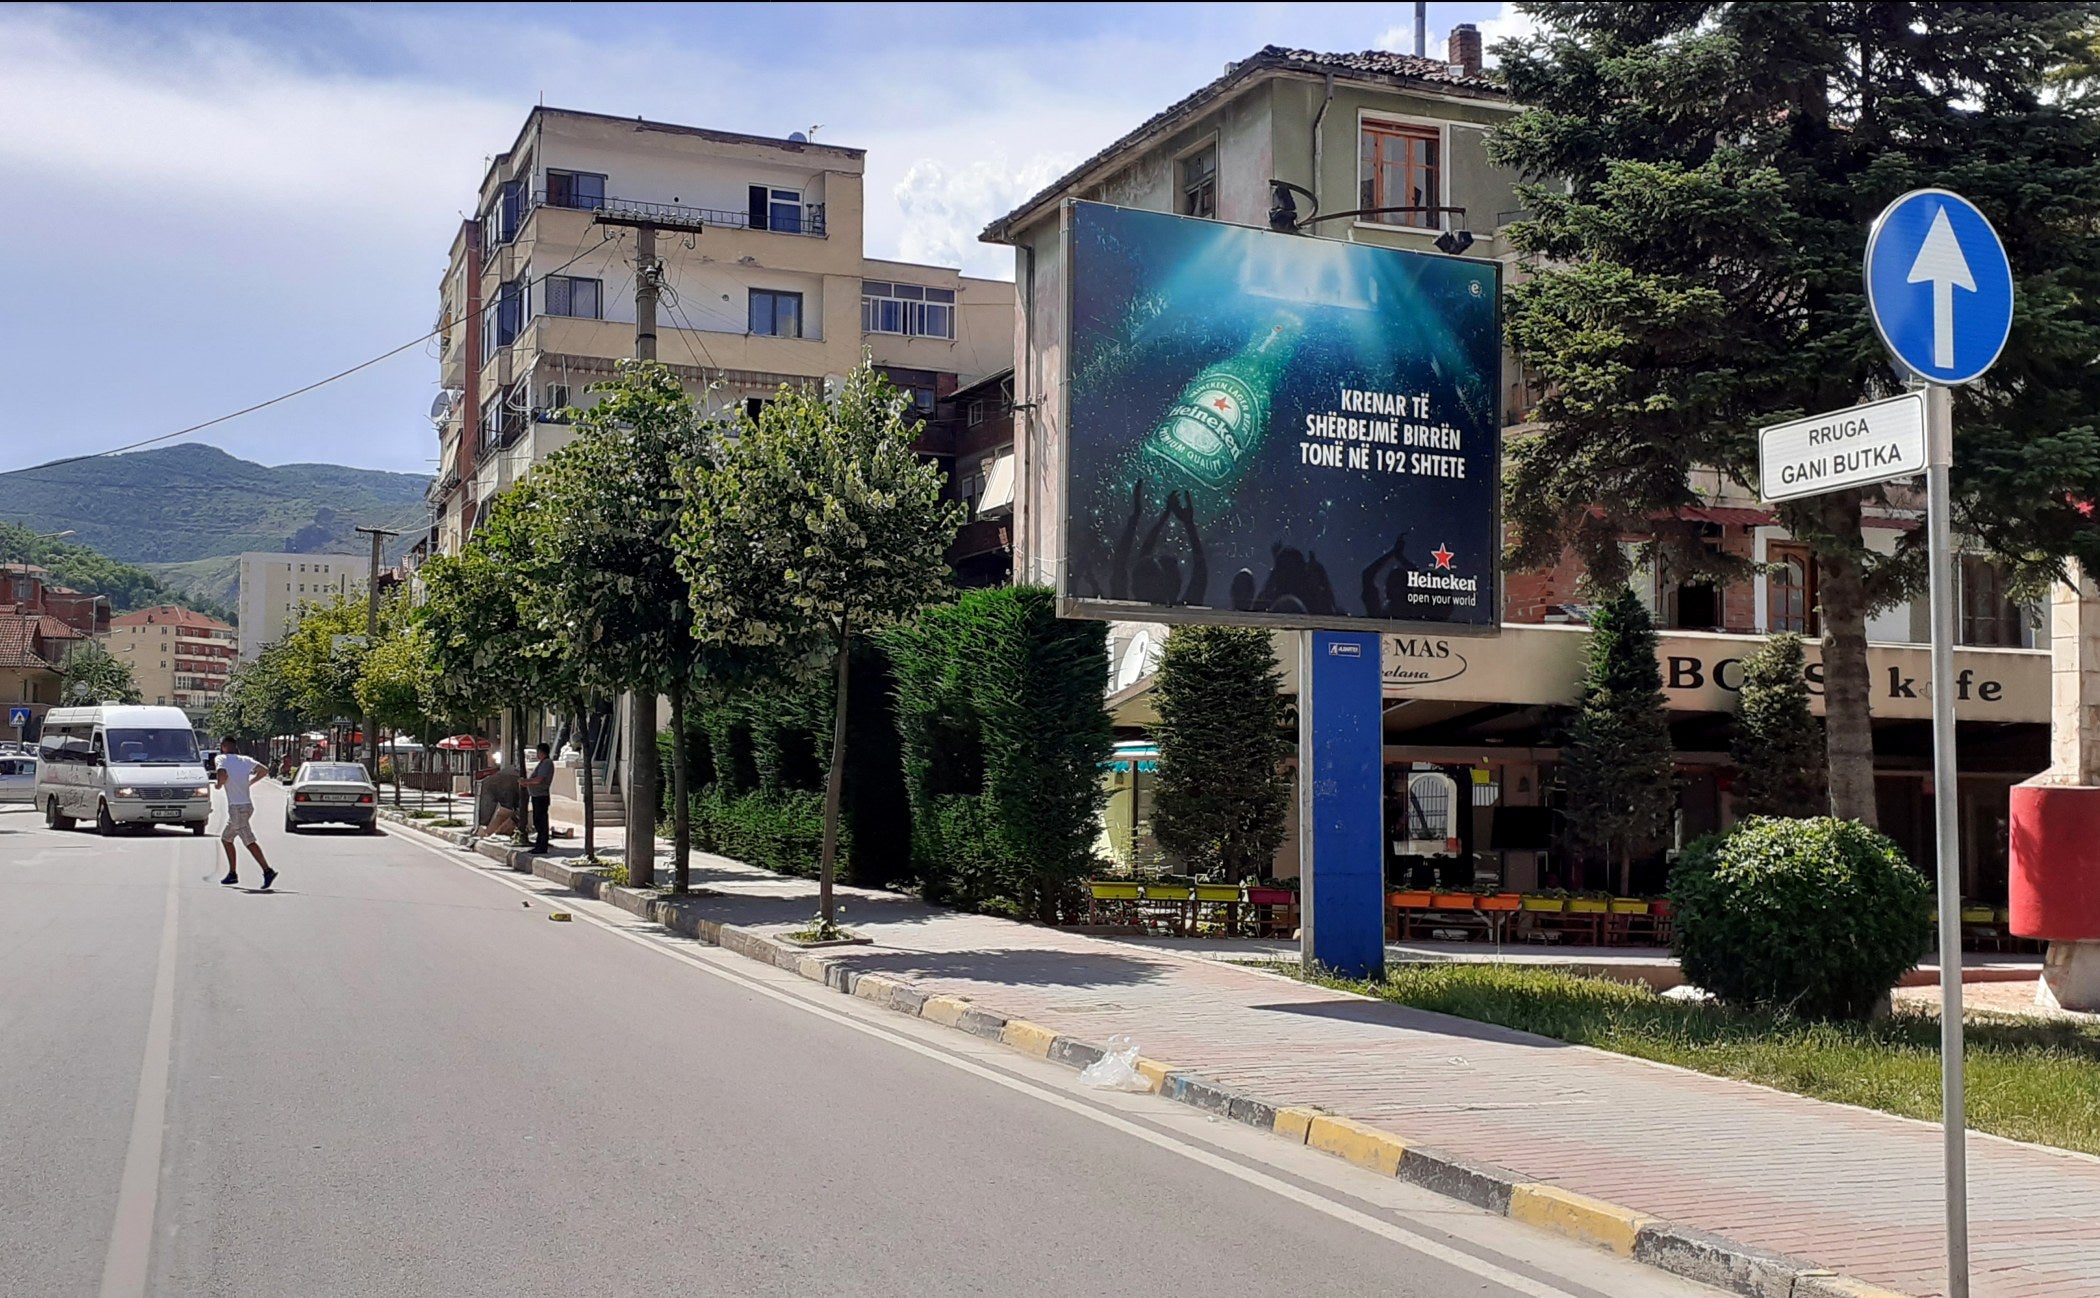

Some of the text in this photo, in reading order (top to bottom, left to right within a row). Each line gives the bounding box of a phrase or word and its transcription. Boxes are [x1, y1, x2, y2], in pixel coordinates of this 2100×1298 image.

[1228, 386, 1250, 412] LAGER
[1341, 389, 1430, 419] KRENAR TË
[1168, 404, 1242, 462] Heineken
[1305, 411, 1462, 451] SHËRBEJMË BIRRËN
[1809, 418, 1870, 446] RRUGA
[1187, 451, 1222, 471] QUALITY
[1299, 440, 1466, 480] TONË NË 192 SHTETE
[1781, 443, 1902, 485] GANI BUTKA
[1407, 570, 1477, 592] Heineken
[1407, 593, 1476, 607] open your world
[1382, 664, 1429, 679] elana
[1667, 656, 2003, 701] BOS kfe
